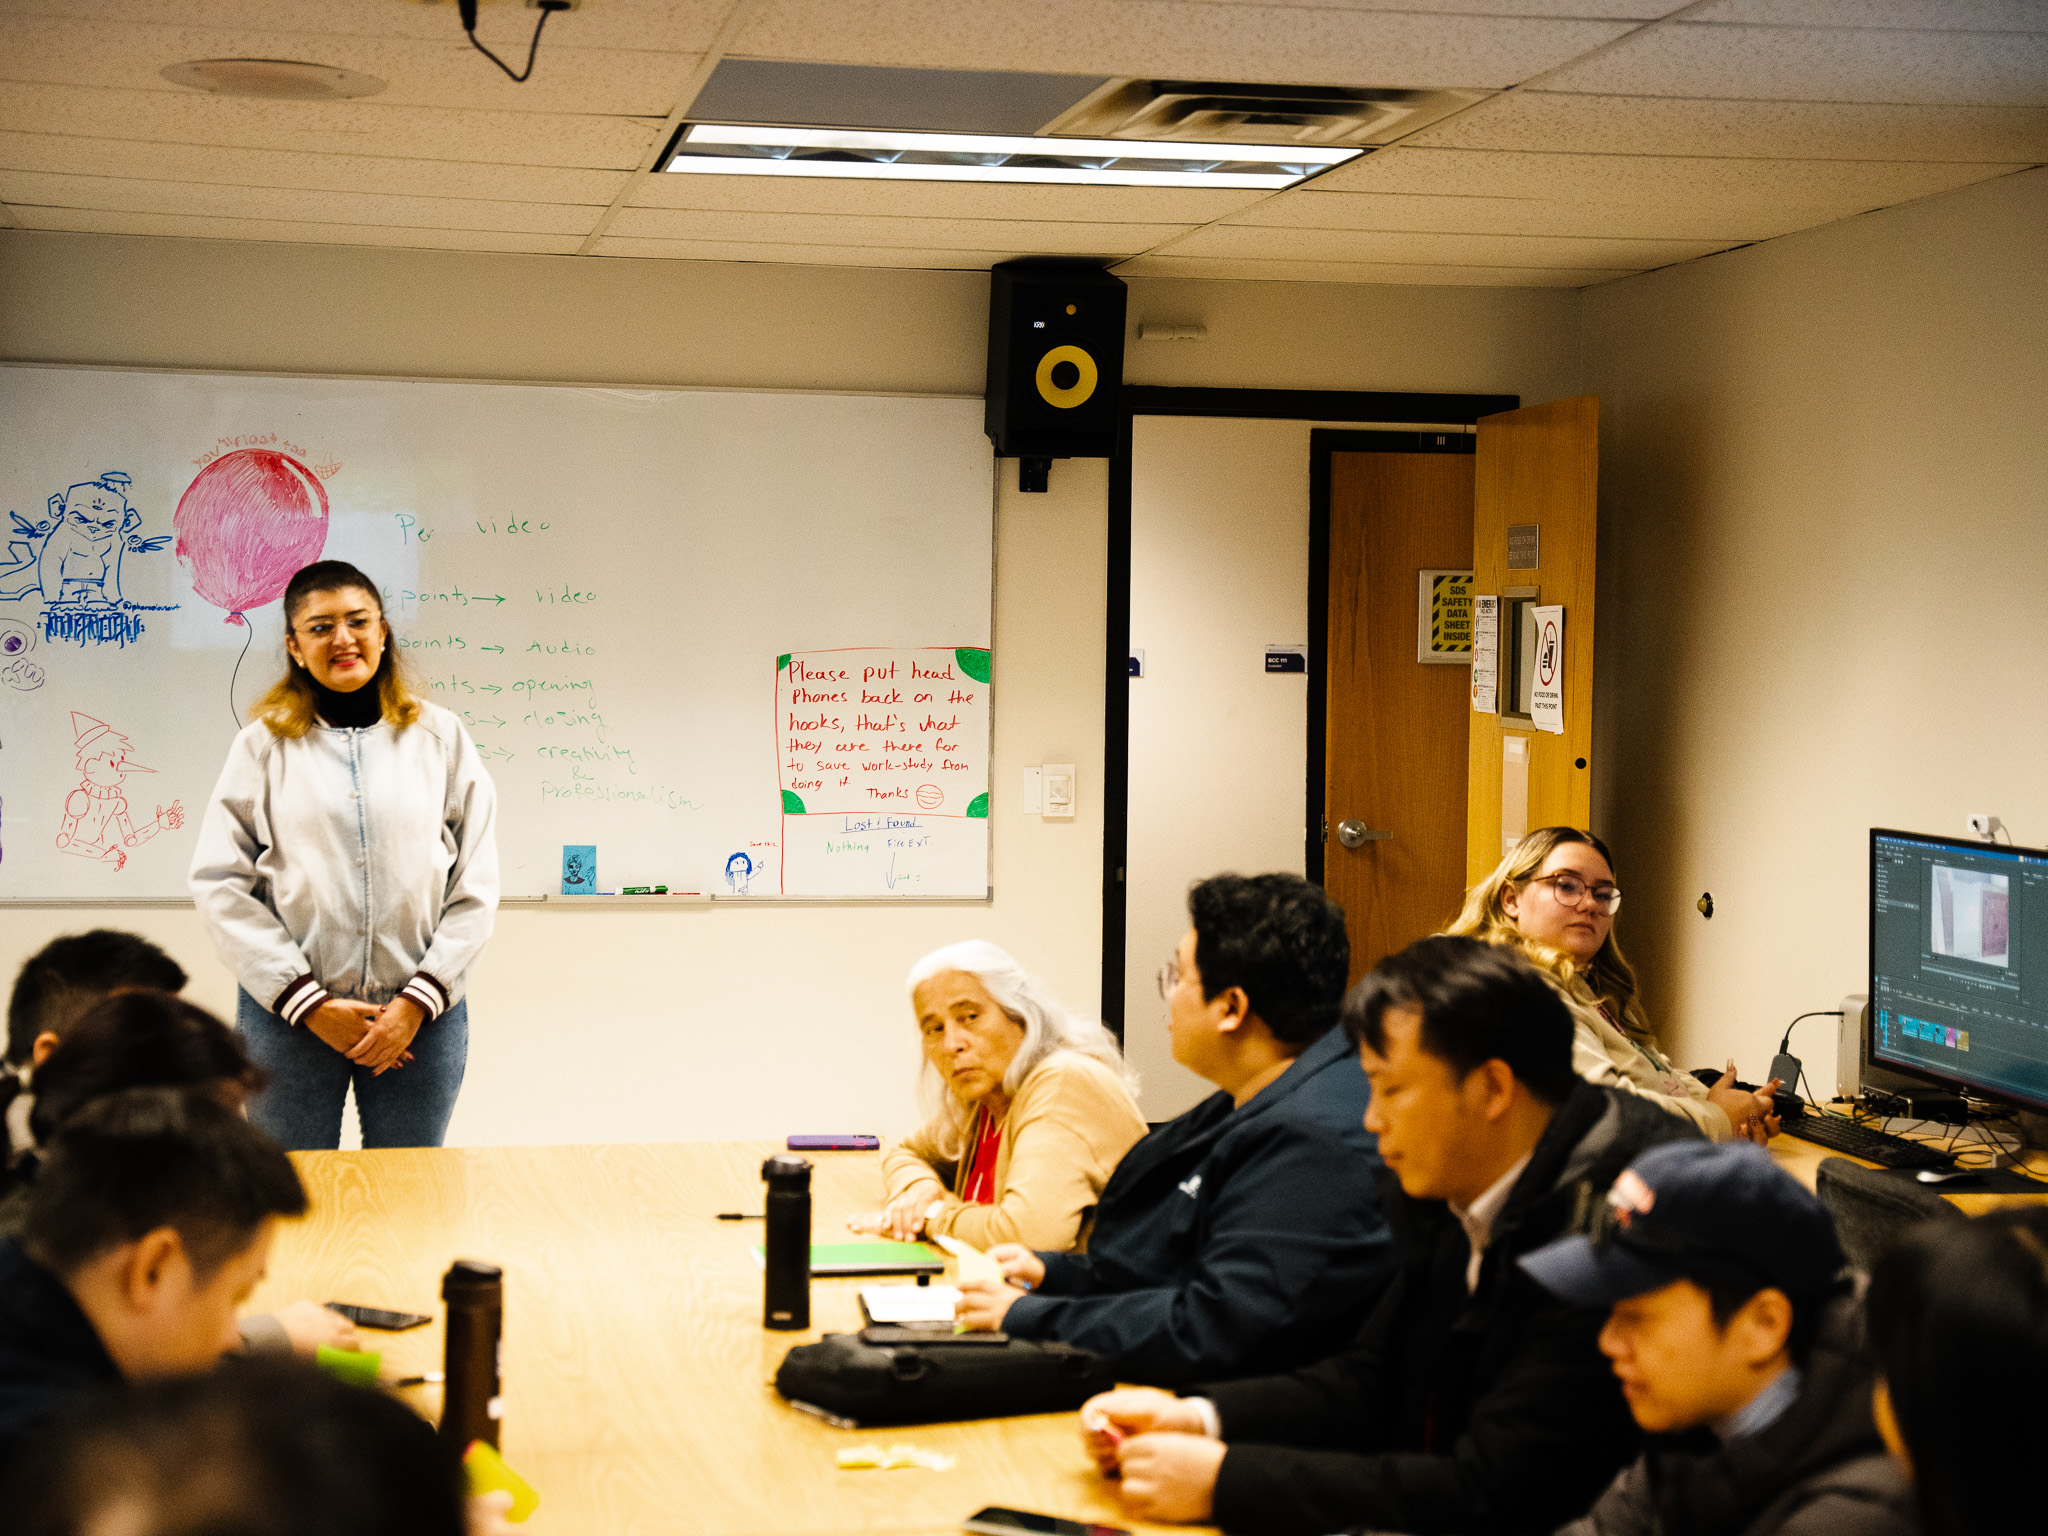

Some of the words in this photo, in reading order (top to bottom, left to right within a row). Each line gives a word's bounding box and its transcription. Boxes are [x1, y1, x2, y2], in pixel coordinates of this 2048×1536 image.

[395, 514, 434, 544] Per
[476, 511, 551, 534] video
[401, 585, 467, 611] points
[536, 583, 597, 604] video
[1450, 586, 1467, 595] SDS
[1442, 598, 1473, 607] SAFETY
[1447, 609, 1468, 618] DATA
[1444, 621, 1470, 630] SHEET
[1443, 632, 1471, 641] INSIDE
[399, 635, 466, 650] points
[525, 641, 596, 656] Audio
[788, 660, 850, 683] Please
[863, 661, 900, 682] put
[912, 661, 955, 681] head
[512, 675, 596, 709] opening
[861, 688, 903, 704] back
[913, 693, 933, 703] on
[947, 690, 974, 705] the
[524, 709, 608, 743] closing
[789, 713, 845, 733] hooks,
[856, 713, 906, 732] that's
[786, 738, 822, 754] they
[835, 742, 870, 752] are
[882, 740, 923, 752] there
[935, 737, 960, 752] for
[572, 766, 594, 780] &
[787, 758, 804, 772] to
[862, 758, 933, 773] work-study
[941, 759, 969, 771] from
[791, 777, 823, 791] doing
[865, 787, 909, 799] Thanks
[846, 816, 872, 831] Lost
[826, 841, 870, 855] Nothing
